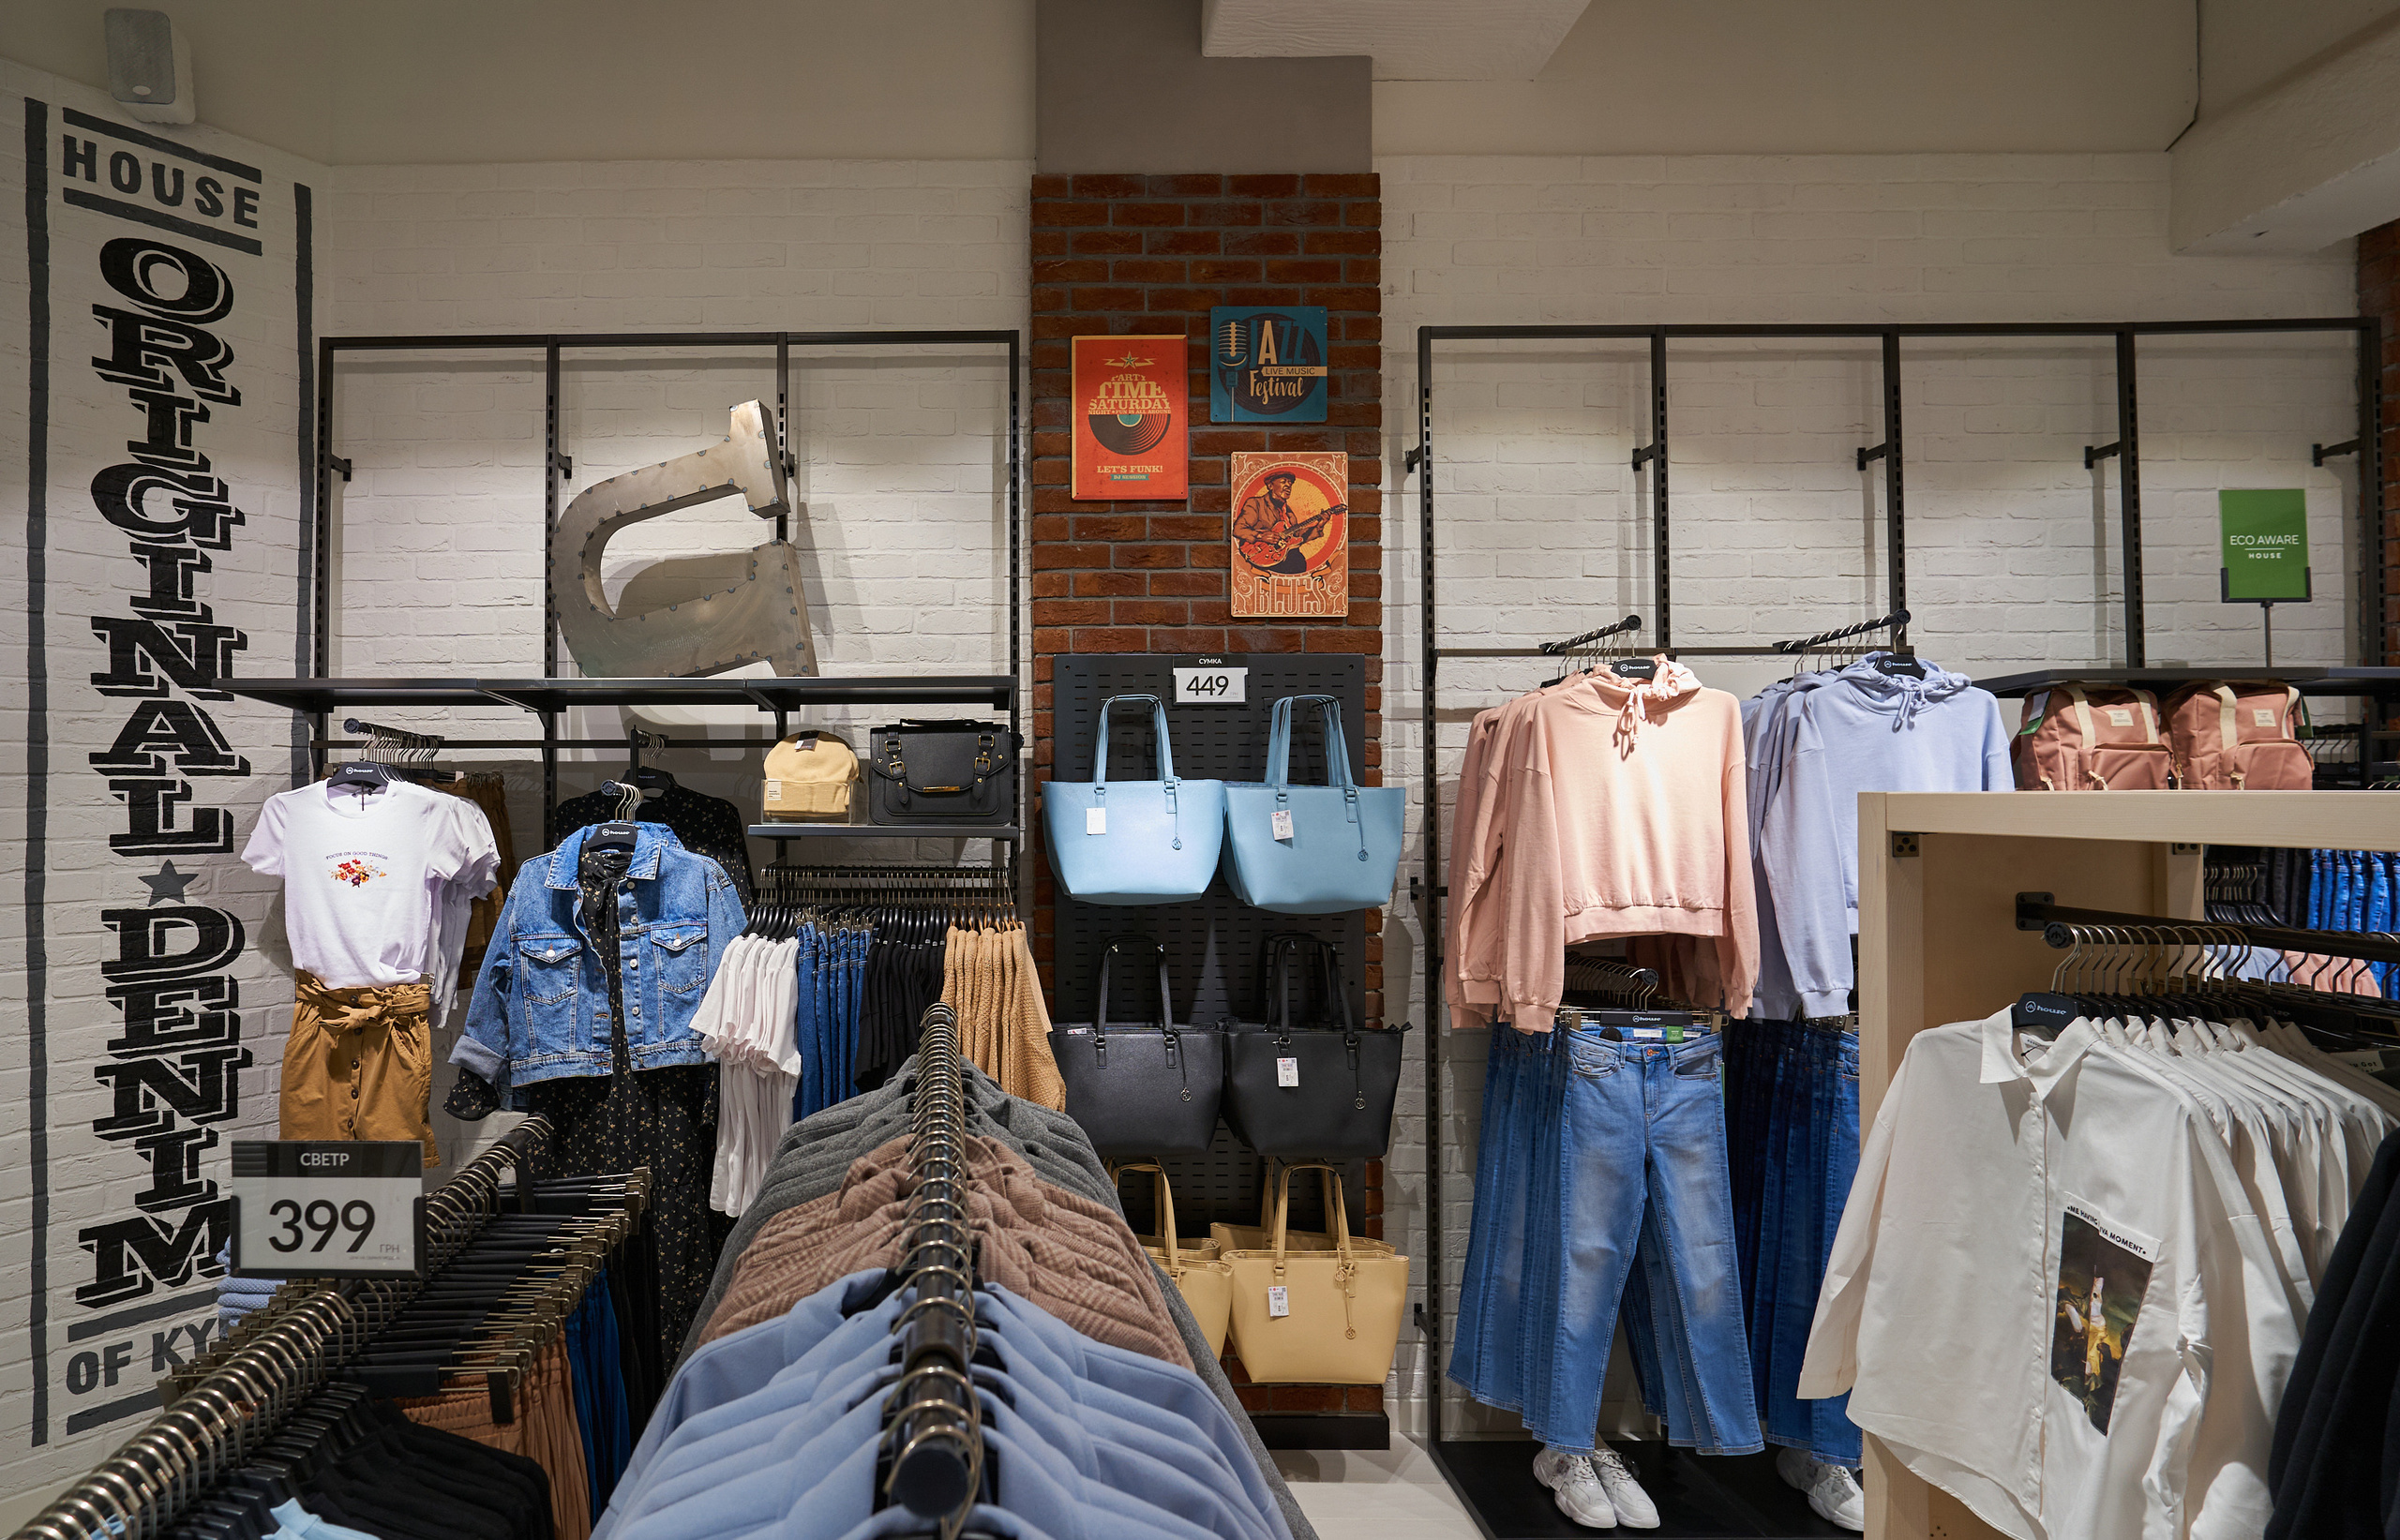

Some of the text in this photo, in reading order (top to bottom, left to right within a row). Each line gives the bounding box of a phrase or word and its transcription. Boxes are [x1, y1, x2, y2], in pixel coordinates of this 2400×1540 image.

[63, 134, 260, 229] HOUSE
[1249, 320, 1307, 369] JAZZ
[1089, 399, 1171, 410] SATURDAY
[1097, 381, 1166, 398] TIME
[1250, 370, 1304, 405] Festival
[89, 237, 250, 857] ORIGINAL
[2229, 534, 2300, 546] ECO AWARE
[1253, 576, 1326, 615] BLUES
[1186, 675, 1229, 696] 449
[75, 906, 252, 1308] DENIM
[300, 1152, 350, 1166] СВЕТР
[268, 1199, 376, 1253] 399
[2109, 1232, 2143, 1253] MOMENT
[380, 1244, 400, 1253] ГРН
[67, 1318, 225, 1395] OF KY
